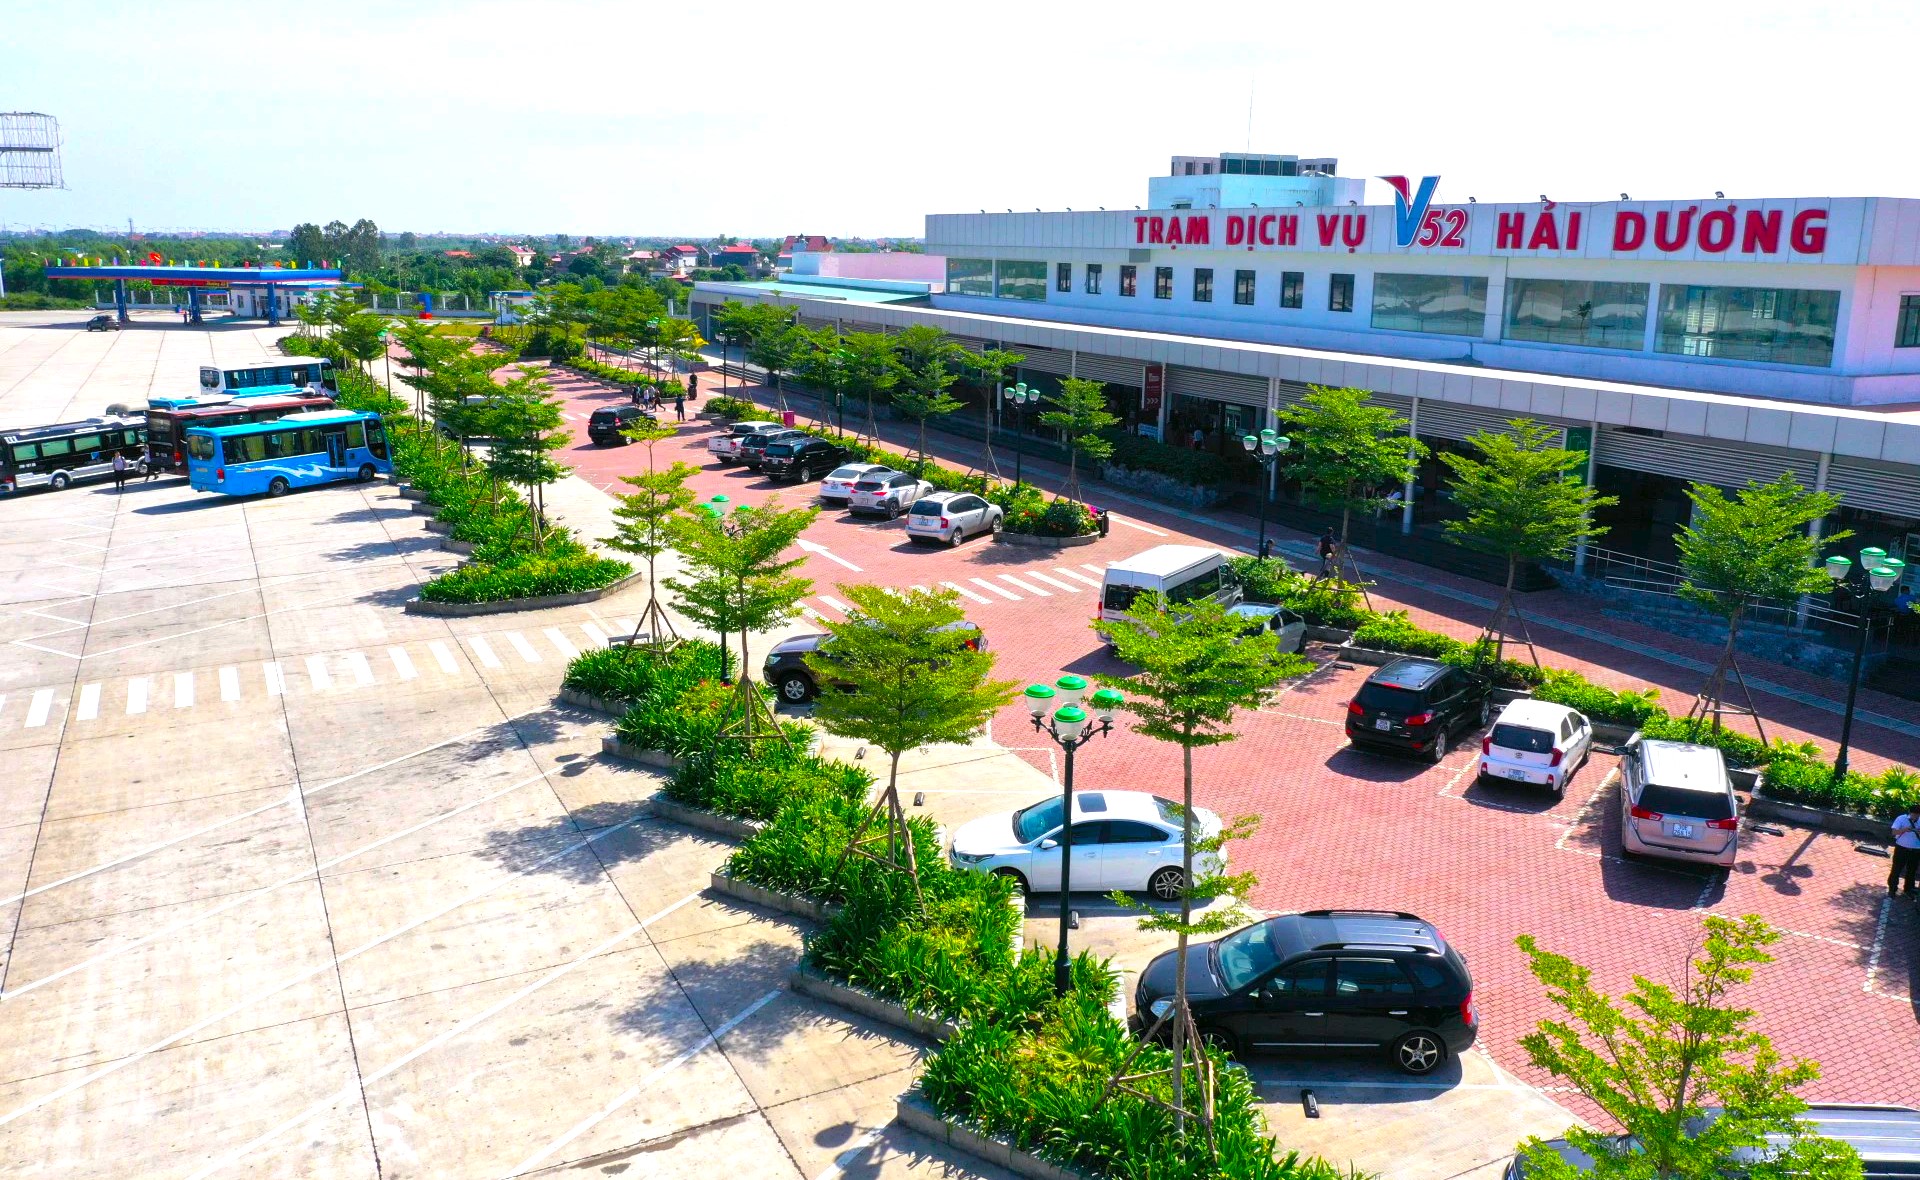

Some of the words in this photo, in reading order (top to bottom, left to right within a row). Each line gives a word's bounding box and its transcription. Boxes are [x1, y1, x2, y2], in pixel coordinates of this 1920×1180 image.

[1134, 216, 1210, 250] TRẠM
[1226, 215, 1298, 251] DỊCH
[1317, 214, 1367, 253] VỤ
[1496, 200, 1581, 251] HẢI
[1613, 205, 1828, 255] DƯƠNG
